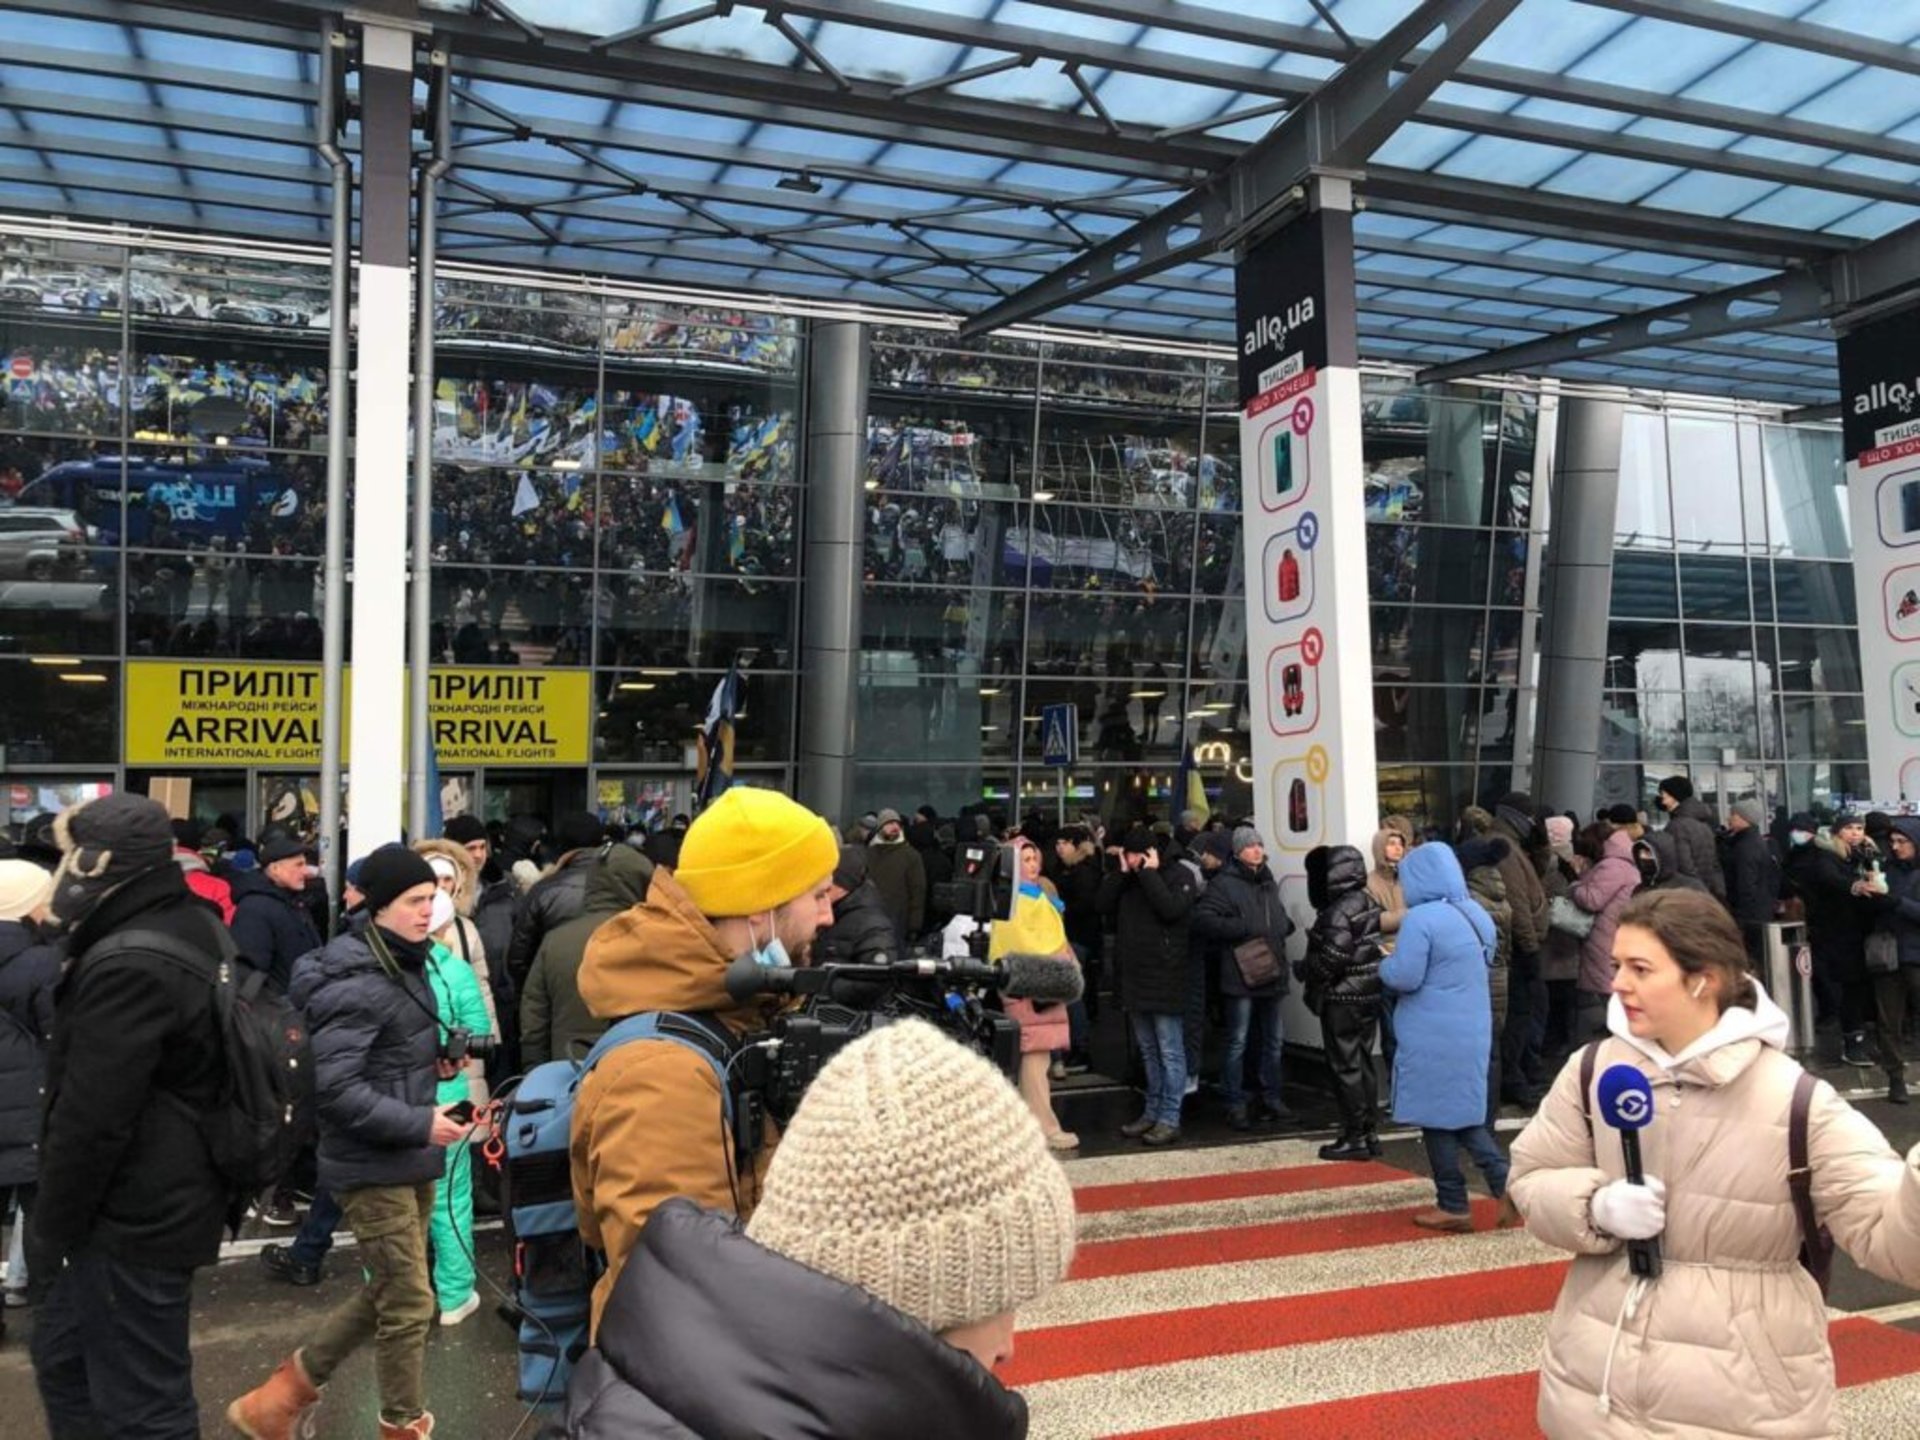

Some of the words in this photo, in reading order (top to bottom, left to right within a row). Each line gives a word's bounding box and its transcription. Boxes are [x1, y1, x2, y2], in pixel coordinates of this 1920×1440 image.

[1244, 296, 1315, 355] allo.ua
[1882, 423, 1920, 443] ТИЦЯ
[179, 669, 319, 697] ПРИЛІТ
[181, 701, 269, 712] МІЖНАРОДНІ
[272, 701, 318, 711] РЕЙСИ
[428, 704, 501, 715] ІЖНАРОДНІ
[503, 704, 545, 714] РЕЙСИ
[165, 717, 322, 744] ARRIVAL
[435, 719, 557, 744] RRIVAL
[164, 747, 271, 758] INTERNATIONAL
[275, 748, 321, 759] FLIGHT
[435, 747, 504, 758] RNATIONAL
[506, 748, 556, 759] FLIGHTS
